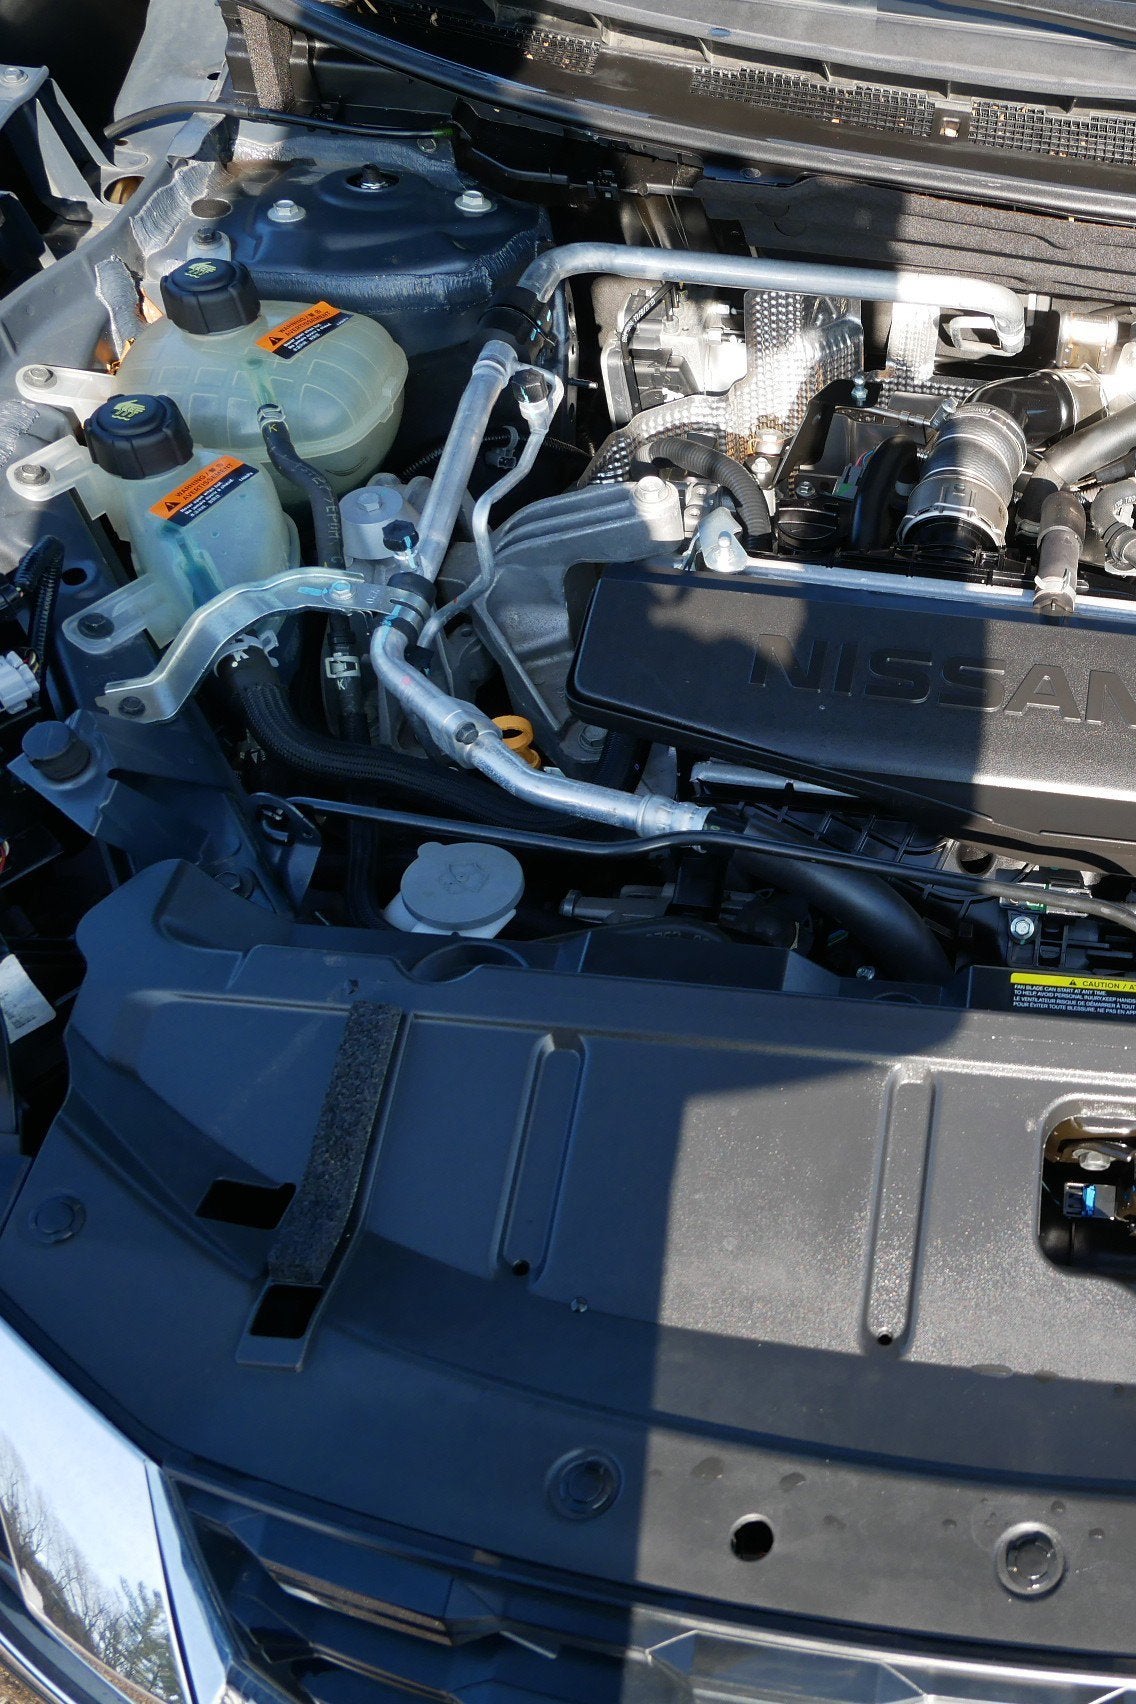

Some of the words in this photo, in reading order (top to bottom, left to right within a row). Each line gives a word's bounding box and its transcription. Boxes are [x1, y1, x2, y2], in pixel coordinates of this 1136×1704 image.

[176, 474, 206, 497] WARNING
[183, 463, 233, 500] AVERTISSEMENT
[1082, 980, 1120, 989] CAUTION
